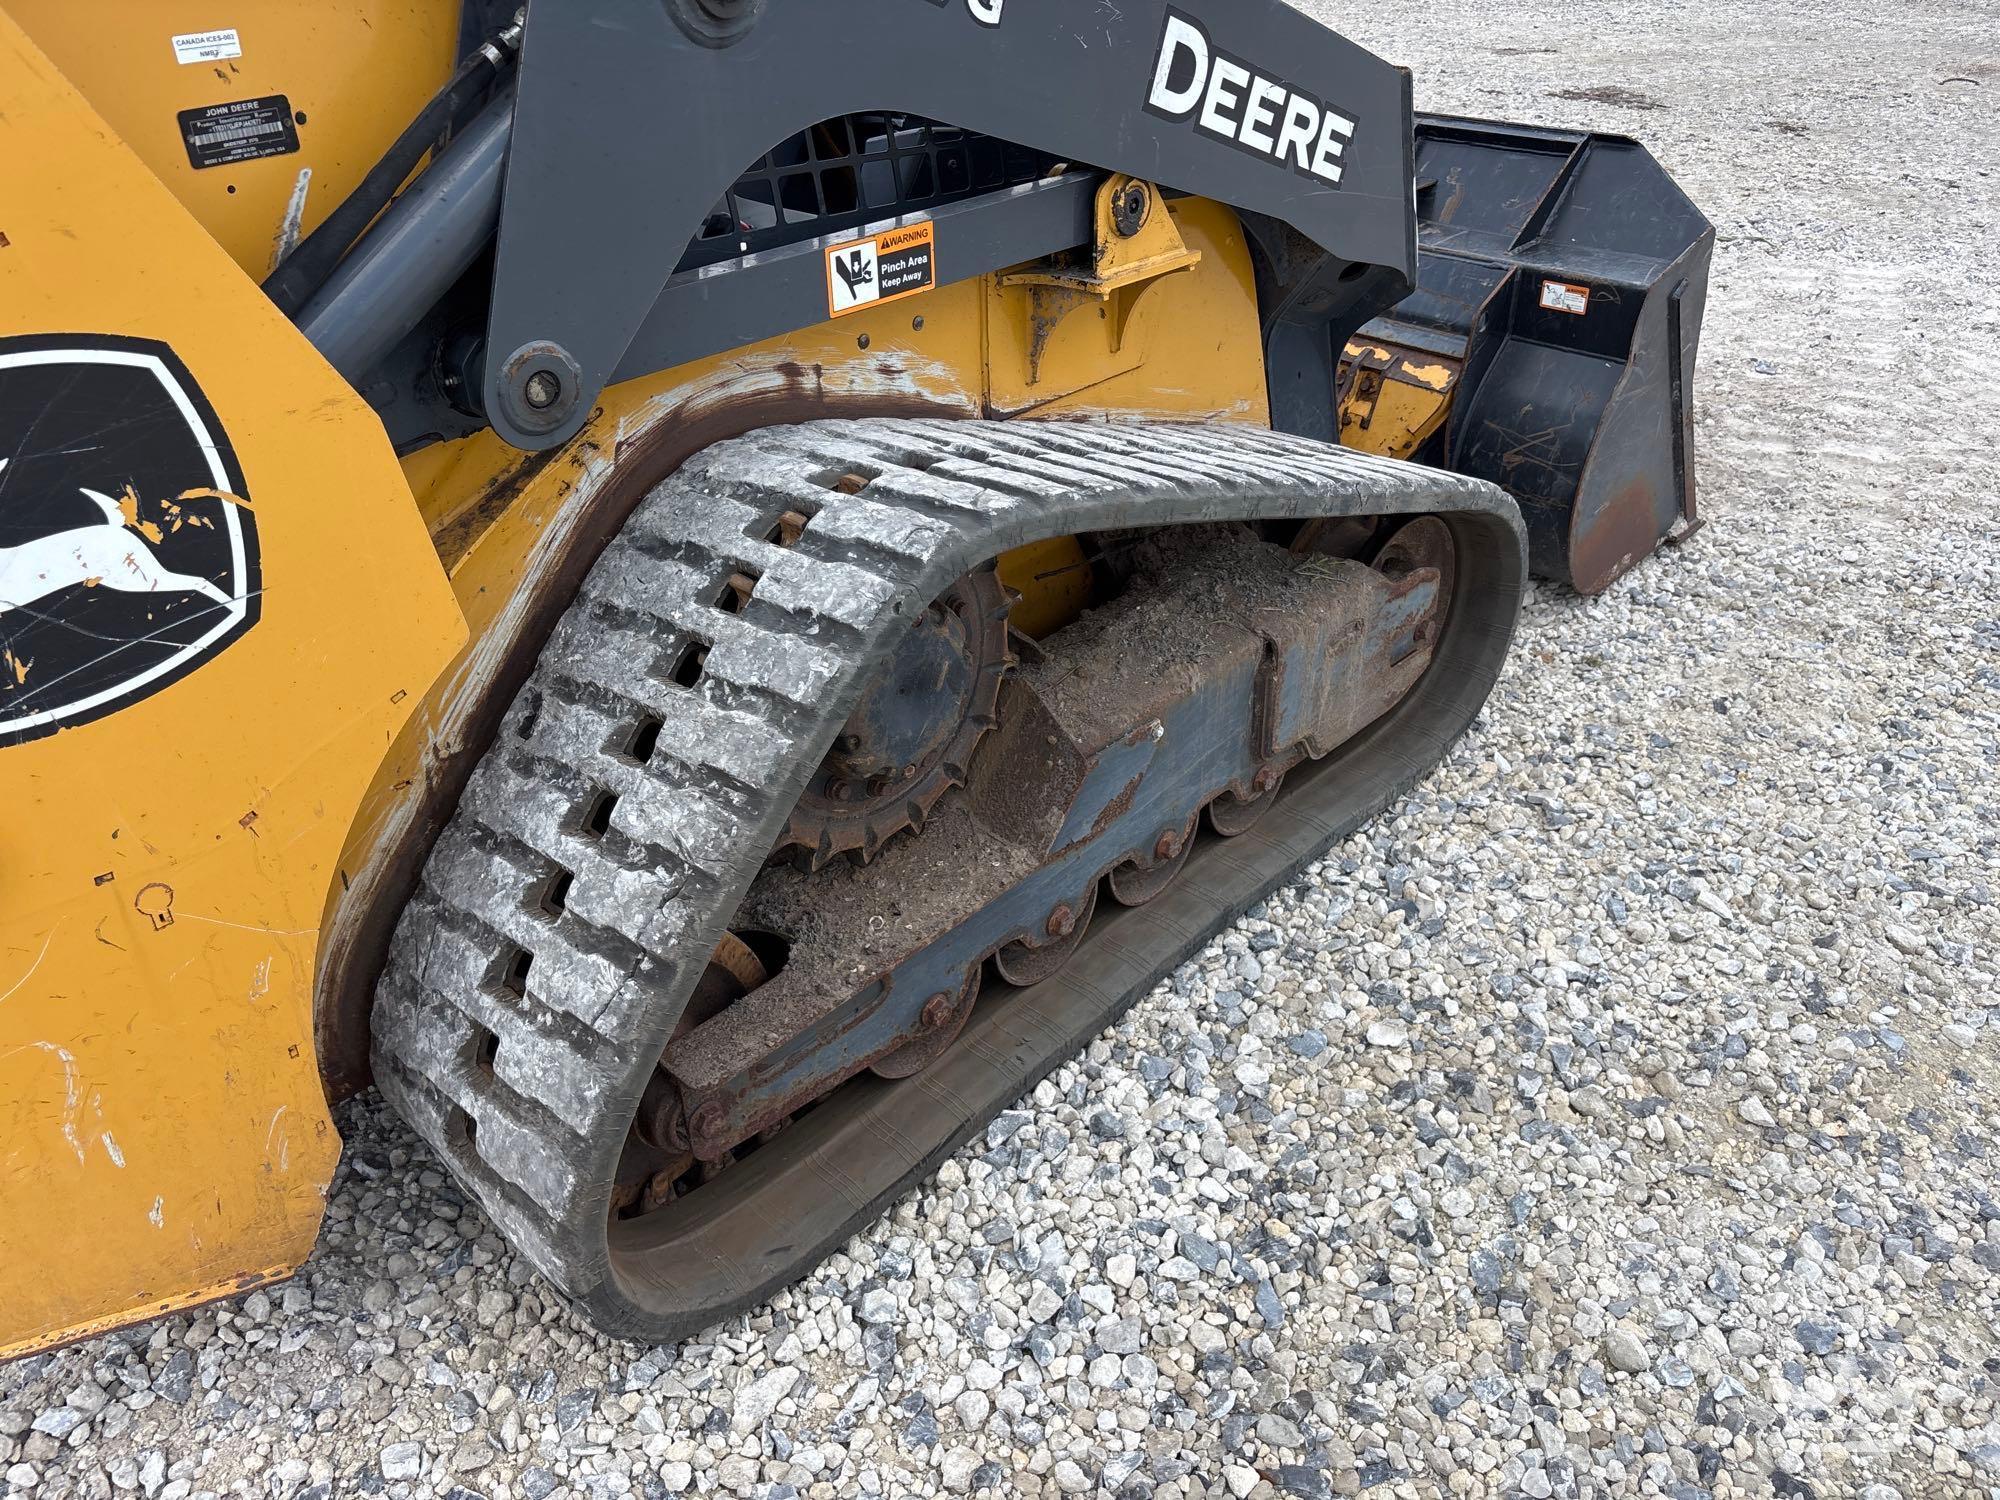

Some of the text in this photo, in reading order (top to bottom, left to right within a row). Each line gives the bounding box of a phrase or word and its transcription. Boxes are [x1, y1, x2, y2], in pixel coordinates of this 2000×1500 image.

[176, 37, 205, 46] CANADA
[1149, 15, 1355, 183] DEERE
[206, 101, 260, 117] JOHN DEERE
[890, 228, 929, 247] WARNING
[881, 255, 928, 275] Pinch Area
[882, 277, 901, 289] Keep
[902, 271, 922, 283] Away
